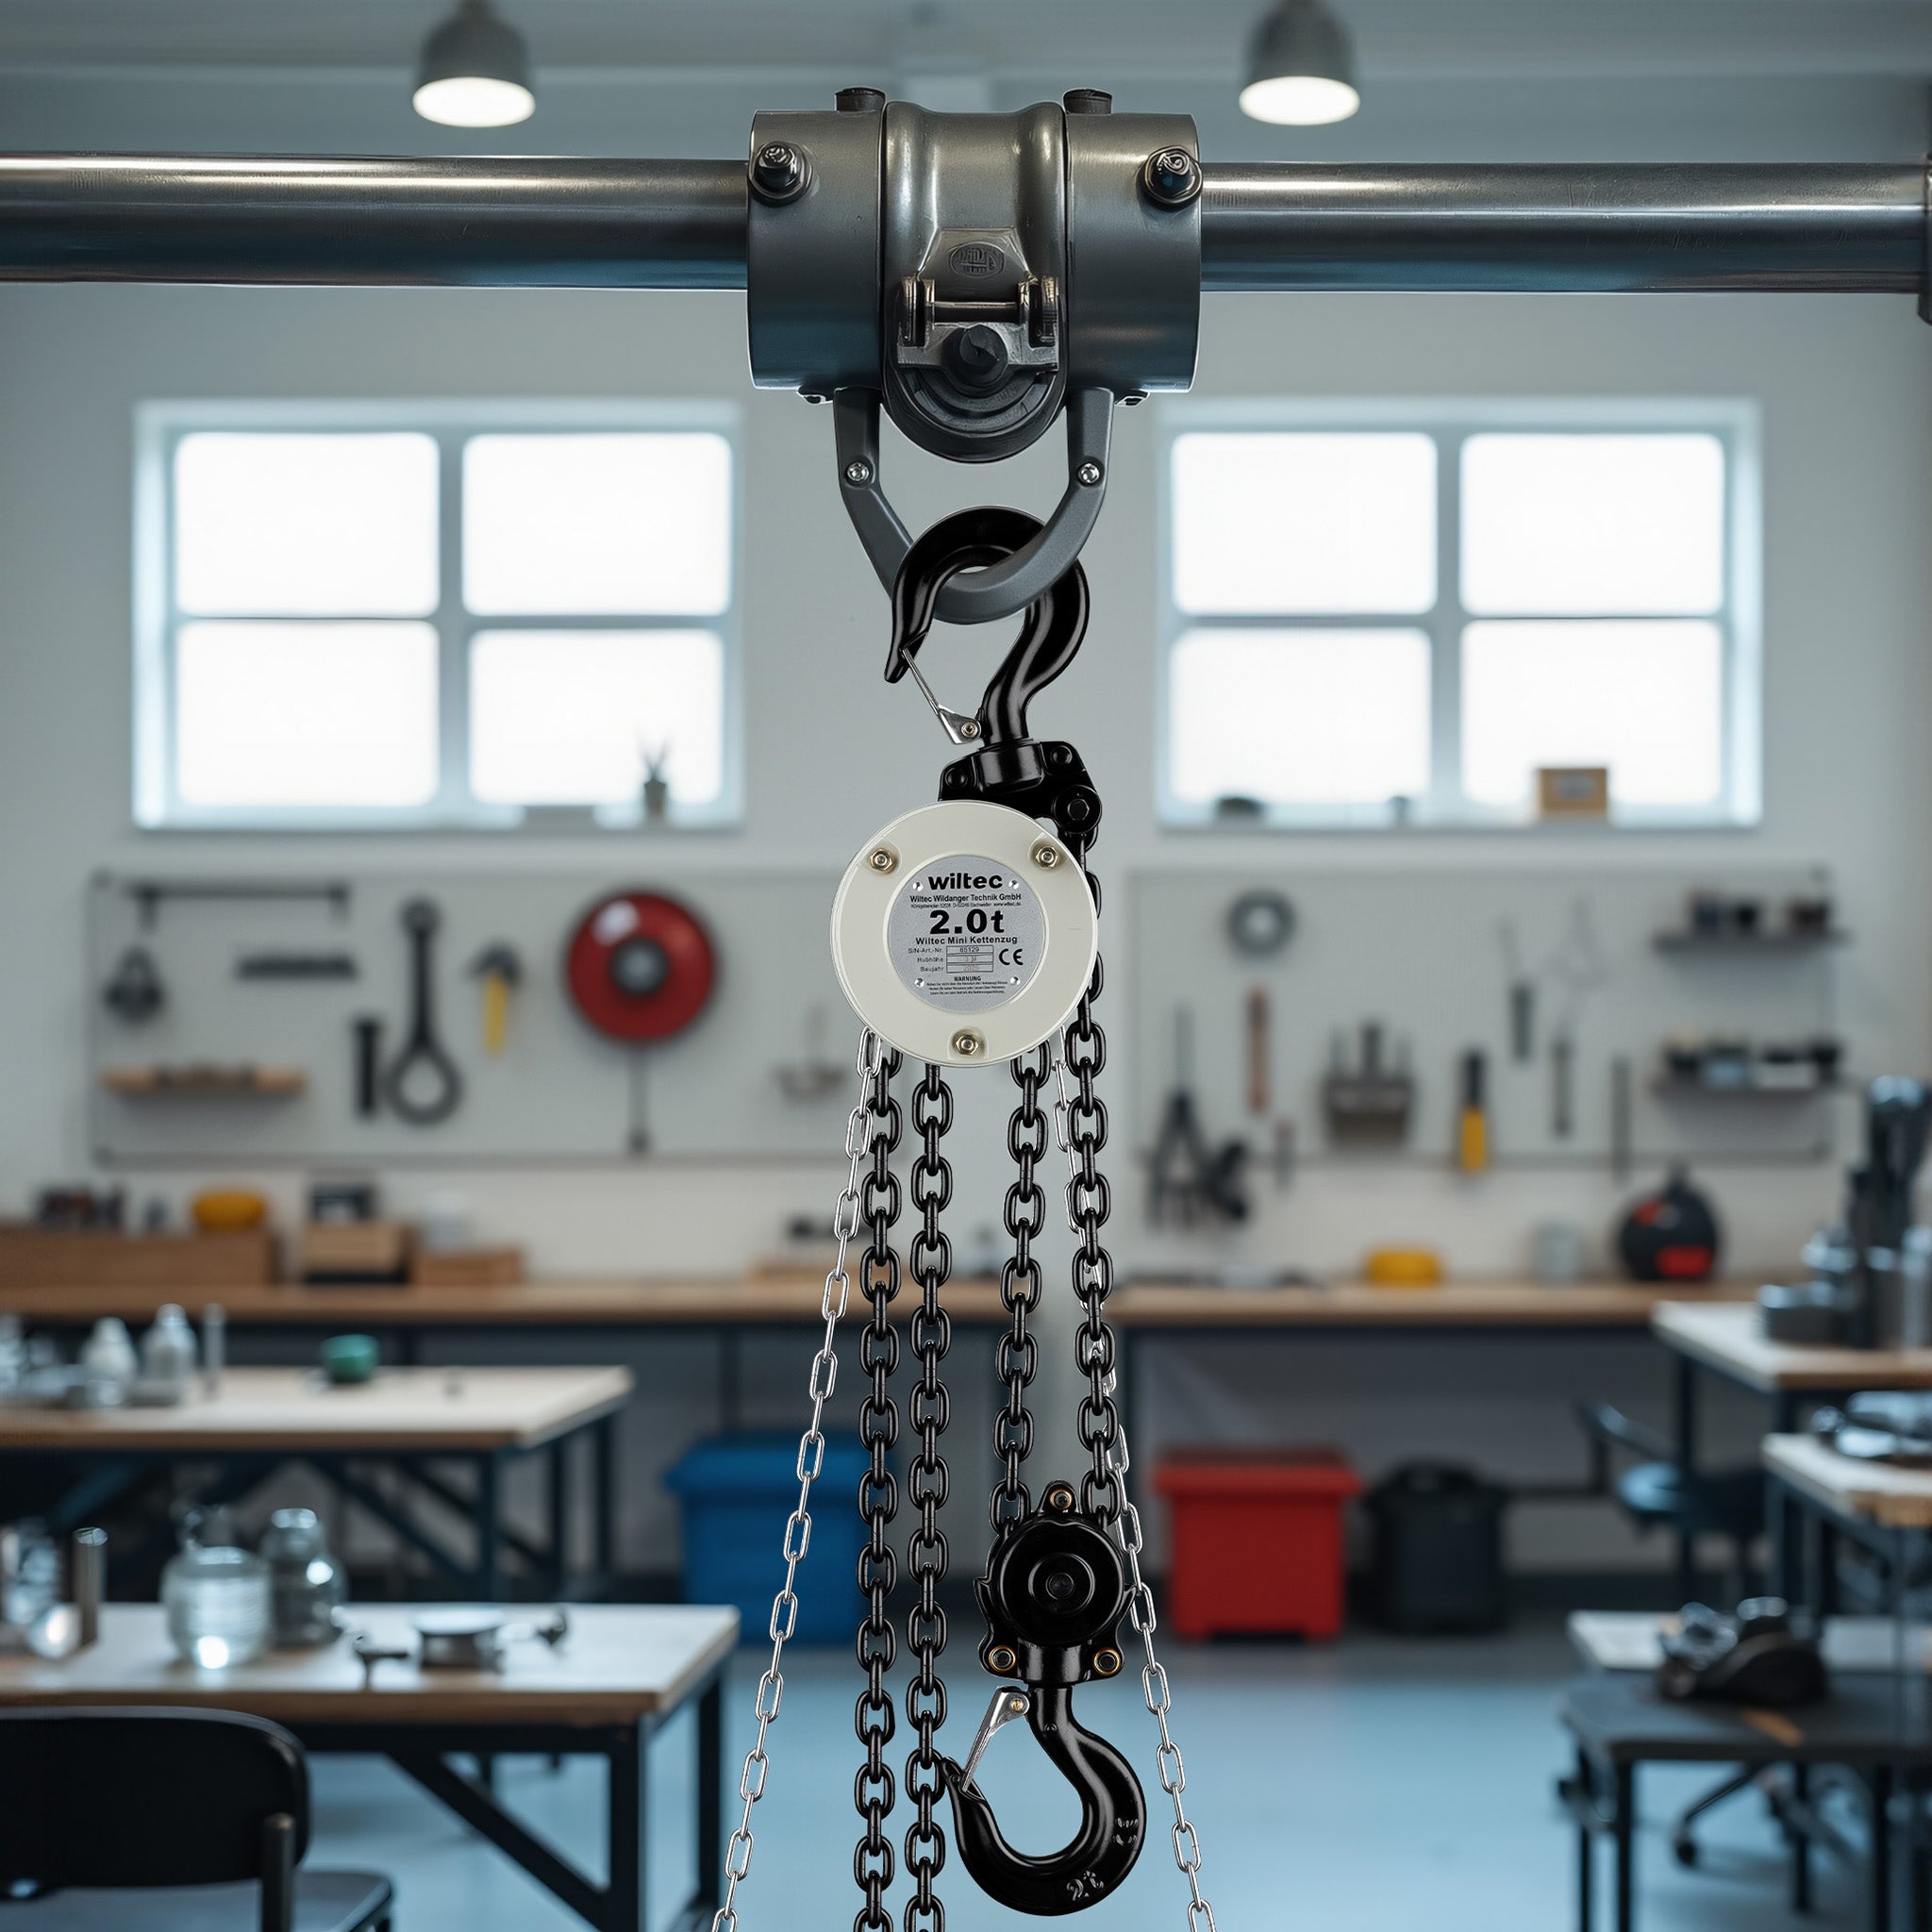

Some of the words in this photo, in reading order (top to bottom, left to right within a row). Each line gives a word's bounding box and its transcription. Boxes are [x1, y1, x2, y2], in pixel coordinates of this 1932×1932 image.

[928, 873, 1003, 890] wiltec
[934, 894, 969, 903] Wildanger
[971, 893, 998, 902] Technik
[929, 908, 1005, 934] 2.0t
[915, 937, 945, 945] Wiltec
[970, 936, 1018, 944] Kettenzug
